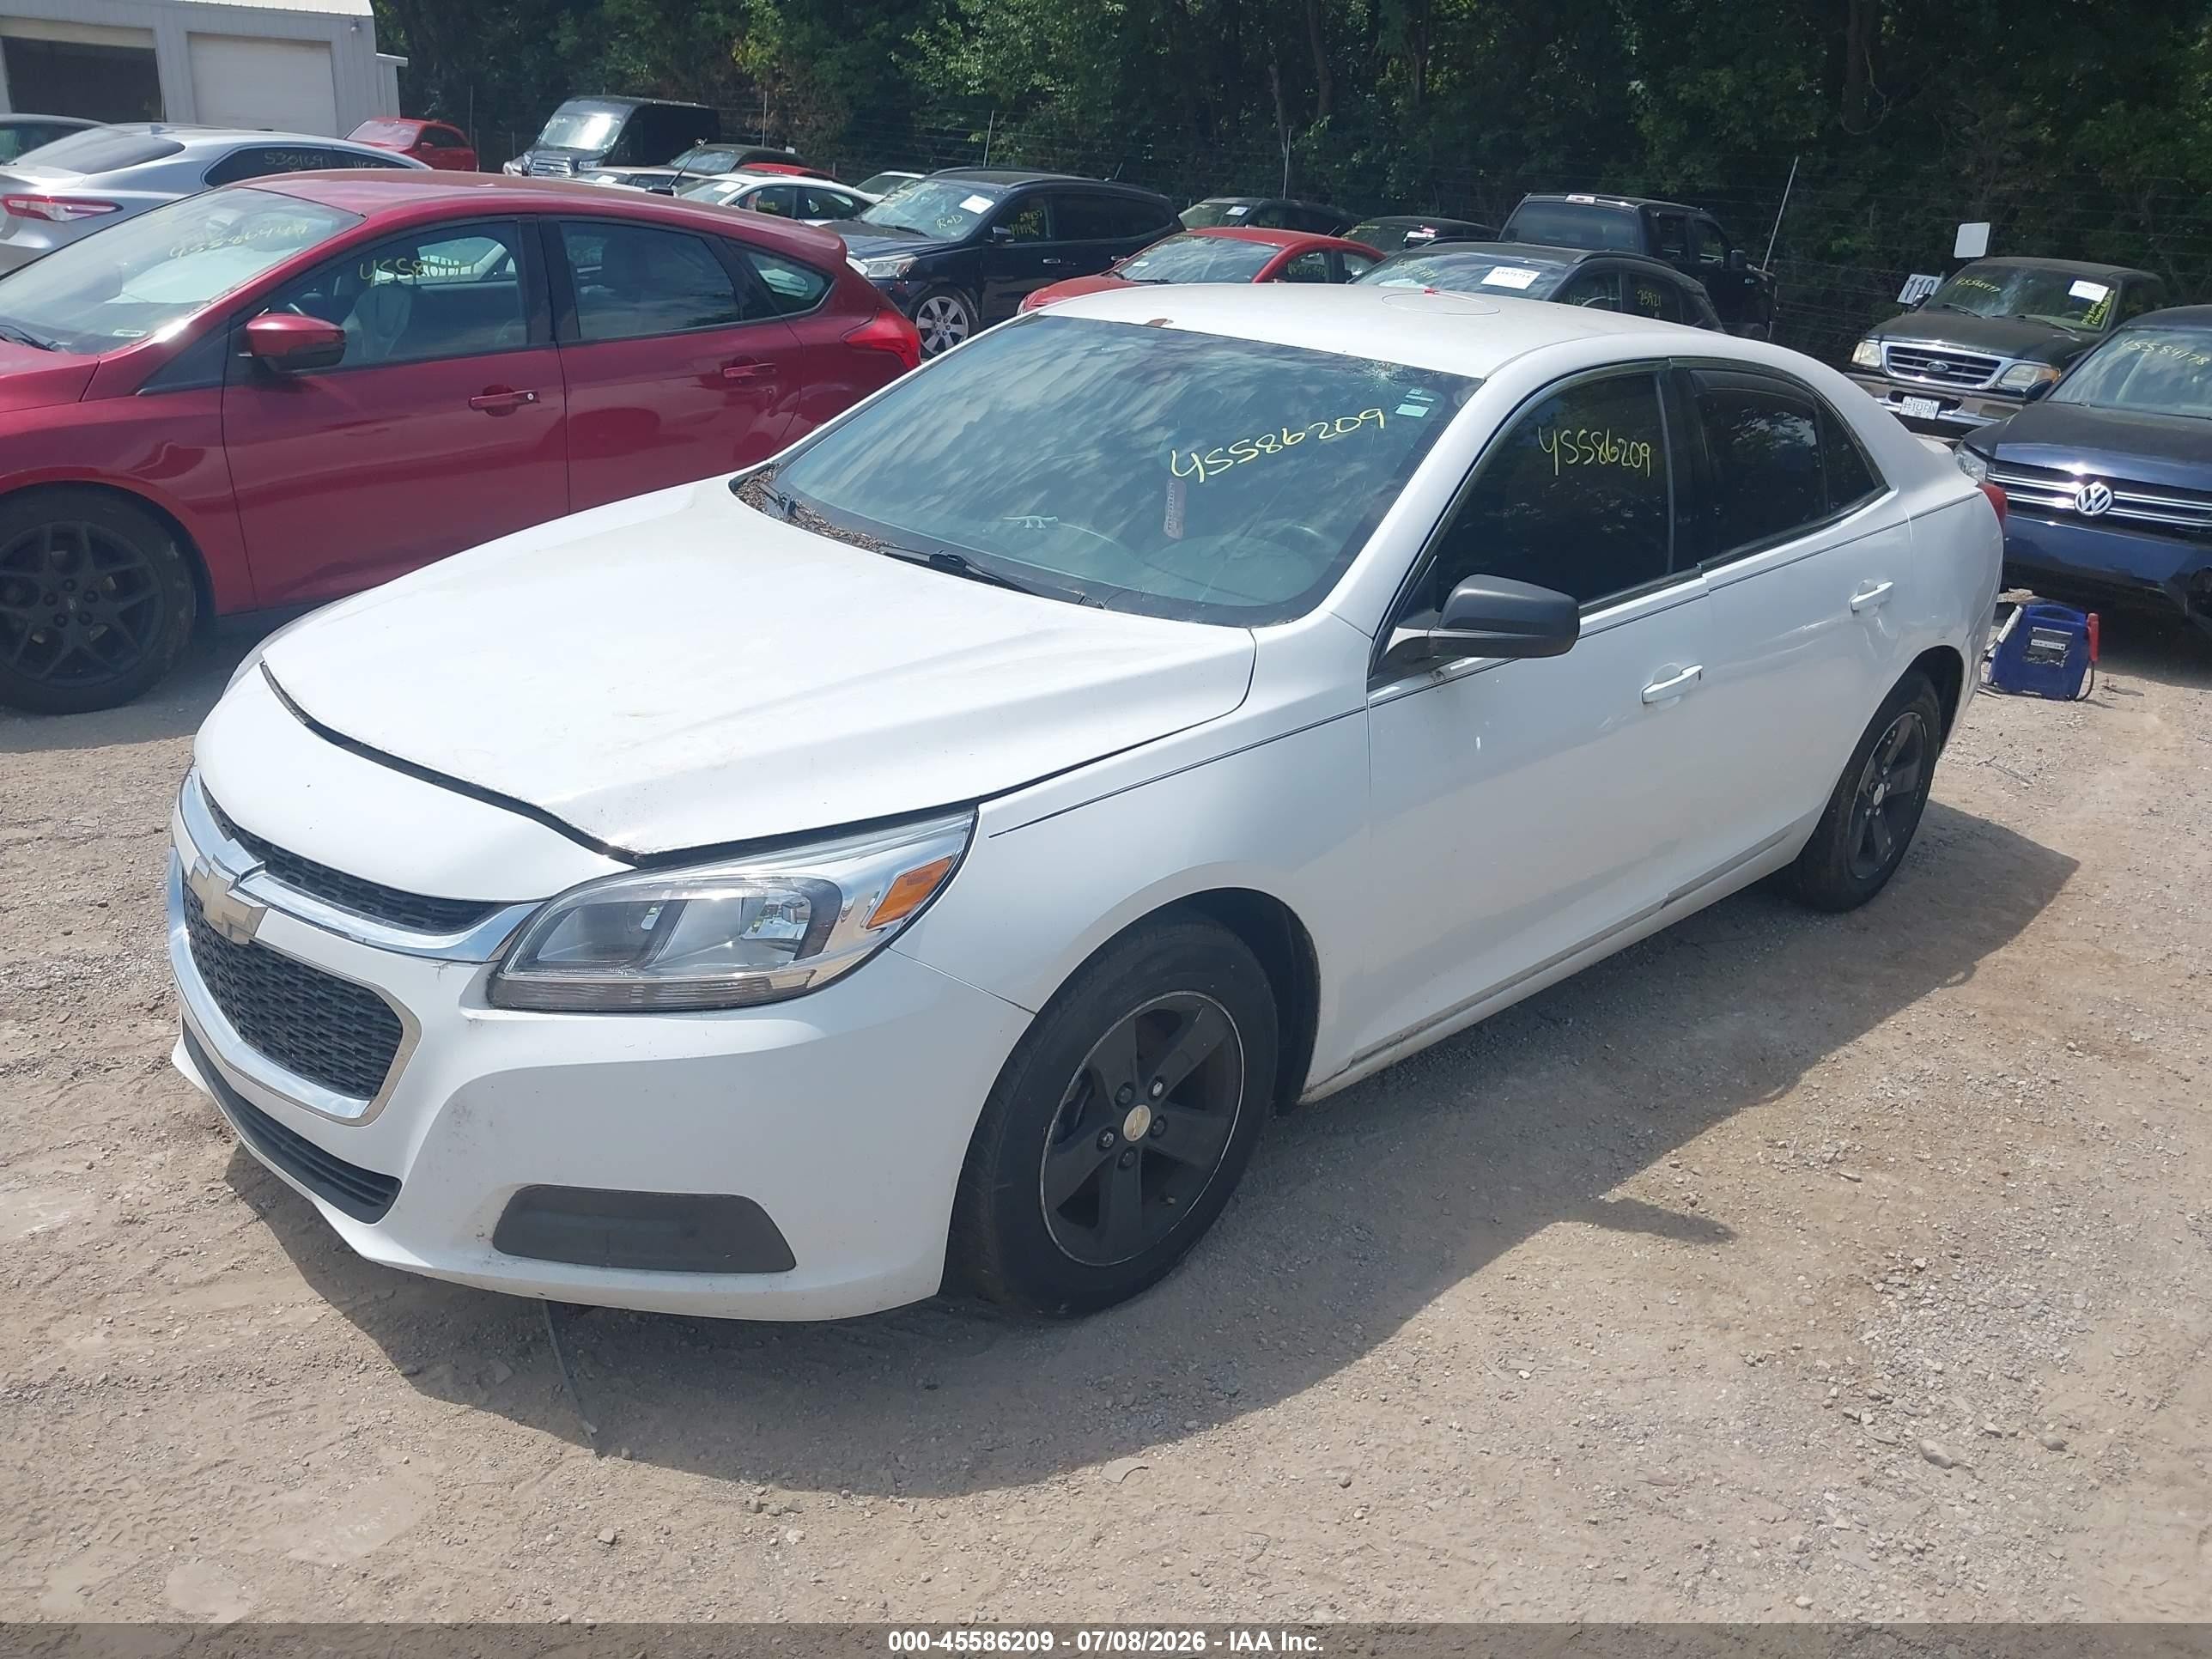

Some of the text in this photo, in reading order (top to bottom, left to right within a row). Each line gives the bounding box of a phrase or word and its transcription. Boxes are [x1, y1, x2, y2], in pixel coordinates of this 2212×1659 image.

[2121, 337, 2211, 366] 45584178
[1170, 407, 1385, 483] 45586209
[1538, 426, 1650, 477] 45586209
